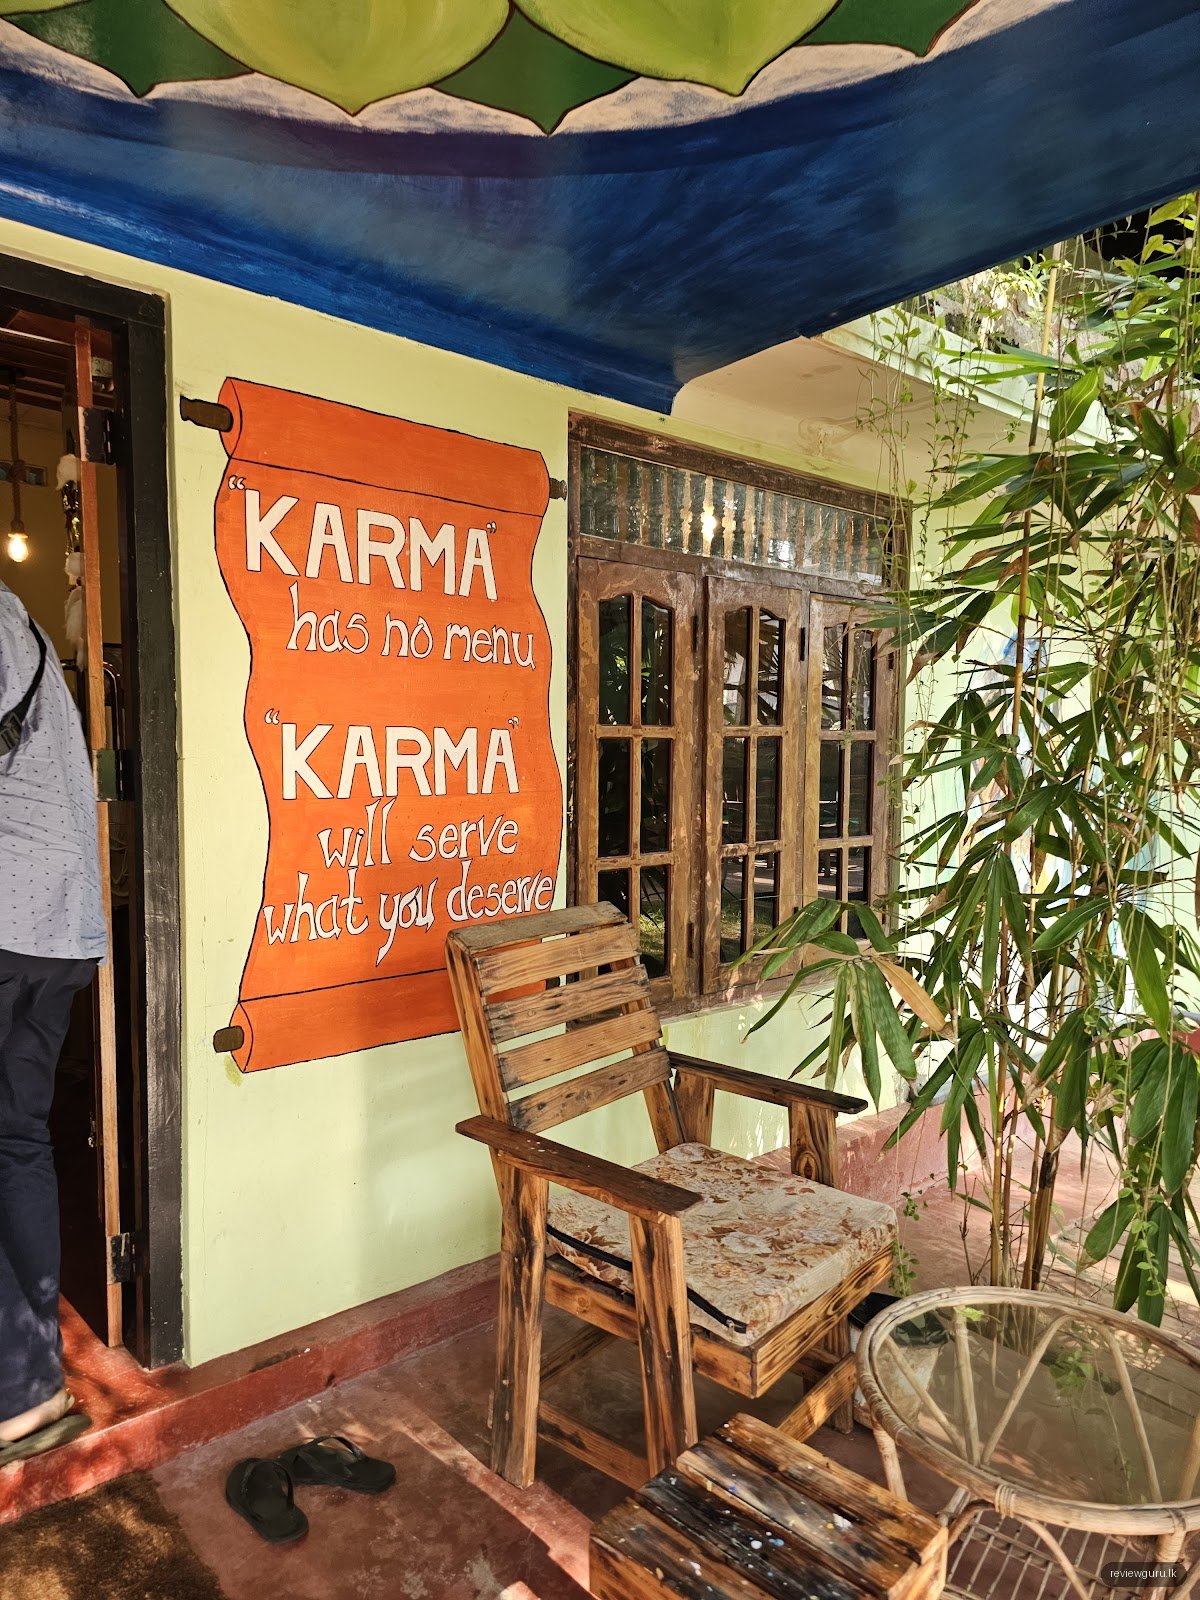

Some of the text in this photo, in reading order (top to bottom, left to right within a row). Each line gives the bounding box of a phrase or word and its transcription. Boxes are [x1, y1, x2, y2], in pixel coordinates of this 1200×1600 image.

[286, 580, 536, 670] has no menu
[317, 797, 519, 869] will serve
[263, 858, 553, 967] what you deserve
